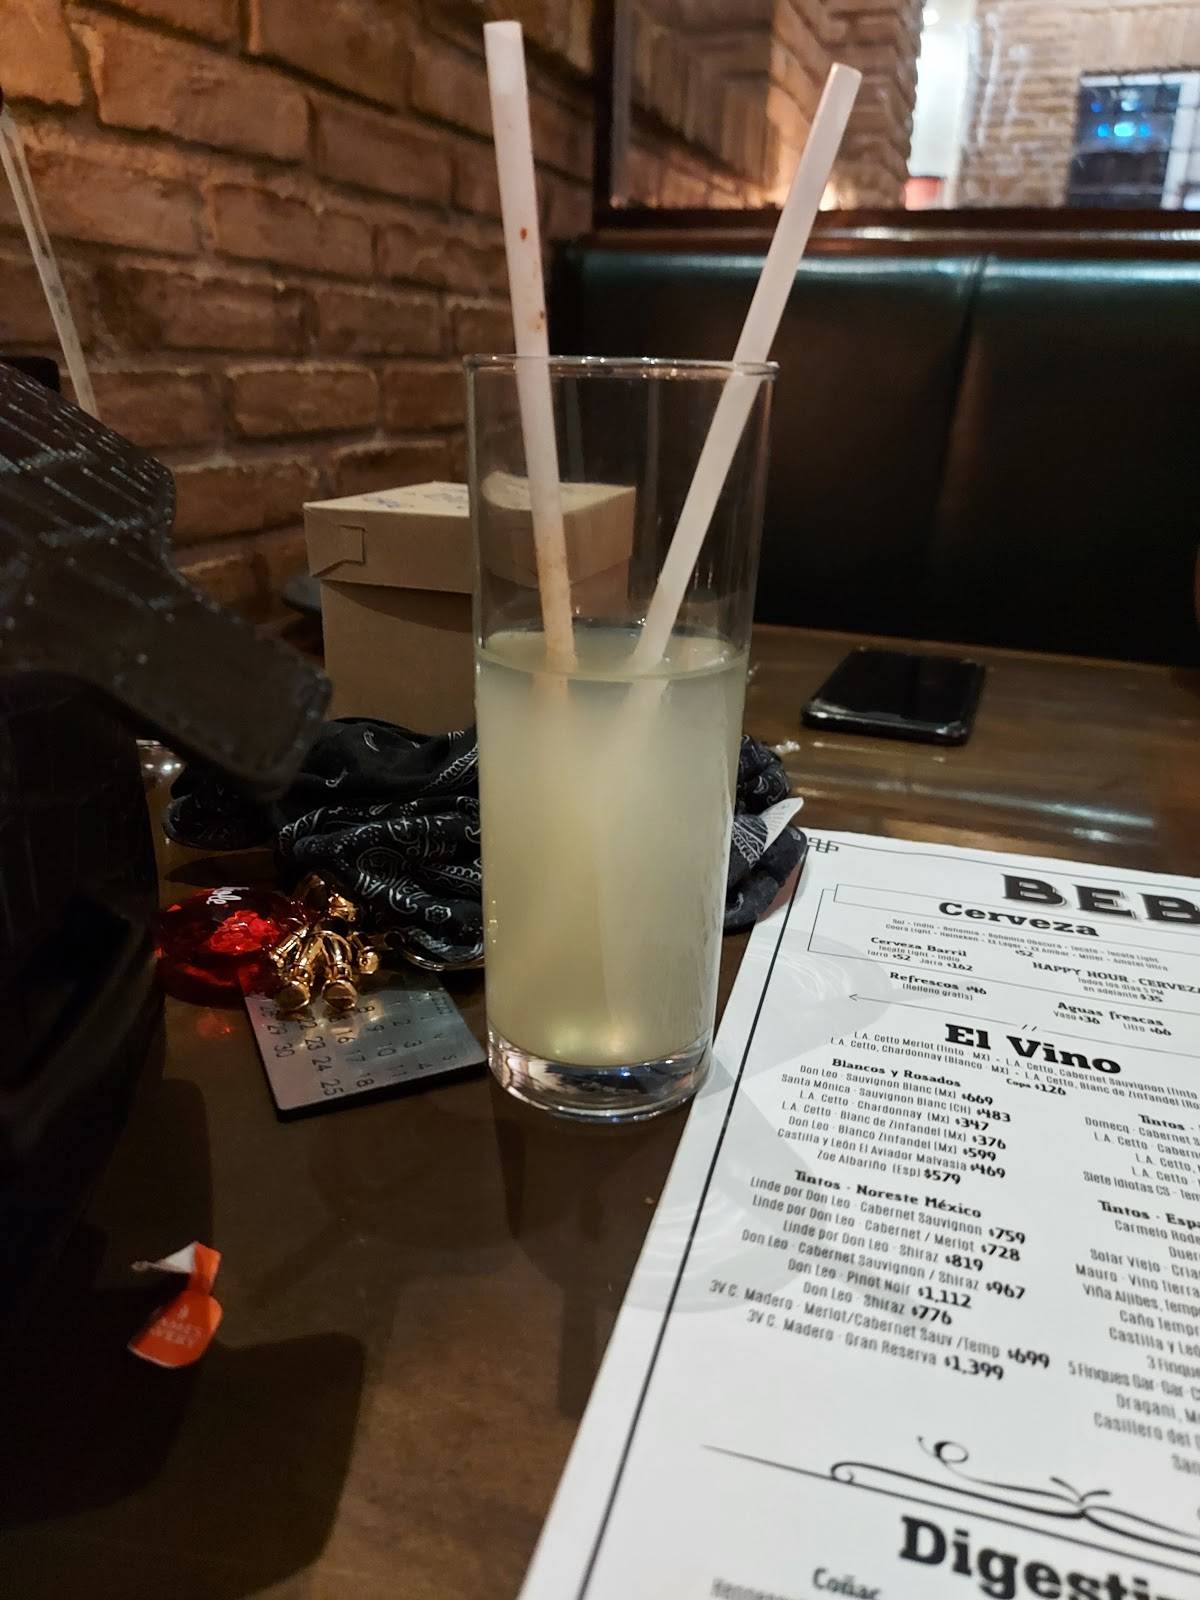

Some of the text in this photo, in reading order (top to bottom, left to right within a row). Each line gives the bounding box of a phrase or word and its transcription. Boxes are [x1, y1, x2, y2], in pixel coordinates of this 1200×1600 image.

[938, 902, 1100, 937] Cerveza
[870, 936, 967, 957] Cerveza Barril
[940, 932, 978, 942] Heineken
[867, 949, 974, 972] Tarro $52 Jarro $162
[878, 945, 960, 962] Tecate Light Indio
[890, 972, 960, 990] Refrescos
[1032, 961, 1082, 976] HAPPY
[1086, 970, 1129, 983] HOUR
[942, 990, 973, 1001] gratis)
[1097, 987, 1164, 1002] adelante $35
[1052, 1010, 1172, 1036] Vaso $36 Litro $66
[1057, 1001, 1164, 1026] Aguas frescas
[274, 1042, 295, 1058] 30
[304, 1036, 326, 1051] 23
[944, 1023, 1122, 1075] El Vino
[311, 1056, 332, 1072] 24
[832, 1058, 962, 1088] Blancos y Rosados
[874, 1032, 1164, 1094] Cetto Merlot Cabernet Sauvignon
[882, 1044, 1180, 1107] Chardonnay Blanc Zinfandel
[320, 1078, 344, 1096] 25
[356, 1072, 374, 1088] 18
[800, 1064, 994, 1106] Don Leo Sauvignon Blanc $669
[1034, 1084, 1066, 1096] $126
[781, 1073, 1012, 1122] Santa Sauvignon Blanc $483
[821, 1093, 990, 1132] Cetto Chardonnay $347
[1138, 1113, 1185, 1131] Tintos
[788, 1115, 997, 1162] Don Leo Blanco Zinfandel $599
[803, 1104, 1006, 1150] Cetto Blanc de Zinfandel $376
[1084, 1116, 1191, 1146] Domecq Cabernet
[777, 1128, 1006, 1179] Castilla y León Aviador $469
[1118, 1136, 1148, 1150] Cetto
[817, 1150, 962, 1185] Zoe Albariño (Esp) $579
[1156, 1170, 1188, 1186] Cetto
[794, 1169, 983, 1218] Tintos Noreste México
[1114, 1178, 1154, 1194] Idiotas
[750, 1176, 1026, 1244] Linde por Don Leo Cabernet Sauvignon $759
[1098, 1199, 1150, 1220] Tintos
[752, 1194, 1020, 1262] Linde por Don Leo Cabernet Merlot $728
[1114, 1220, 1168, 1240] Carmelo
[782, 1219, 984, 1272] Linde por Don Leo Shiraz $819
[742, 1228, 1026, 1300] Don Leo Cabernet Sauvignon Shiraz $967
[1090, 1248, 1161, 1274] Solar Viejo
[788, 1258, 972, 1310] Don Leo Pinot Noir $1,112
[1075, 1263, 1159, 1291] Mauro Vino
[803, 1281, 952, 1326] Don Leo Shiraz $776
[744, 1287, 1051, 1370] Madero Merlot/Cabernet $699
[1109, 1326, 1164, 1351] Castilla
[782, 1317, 1005, 1381] Madero Gran Reserva $1,399
[1094, 1412, 1164, 1442] Casillero
